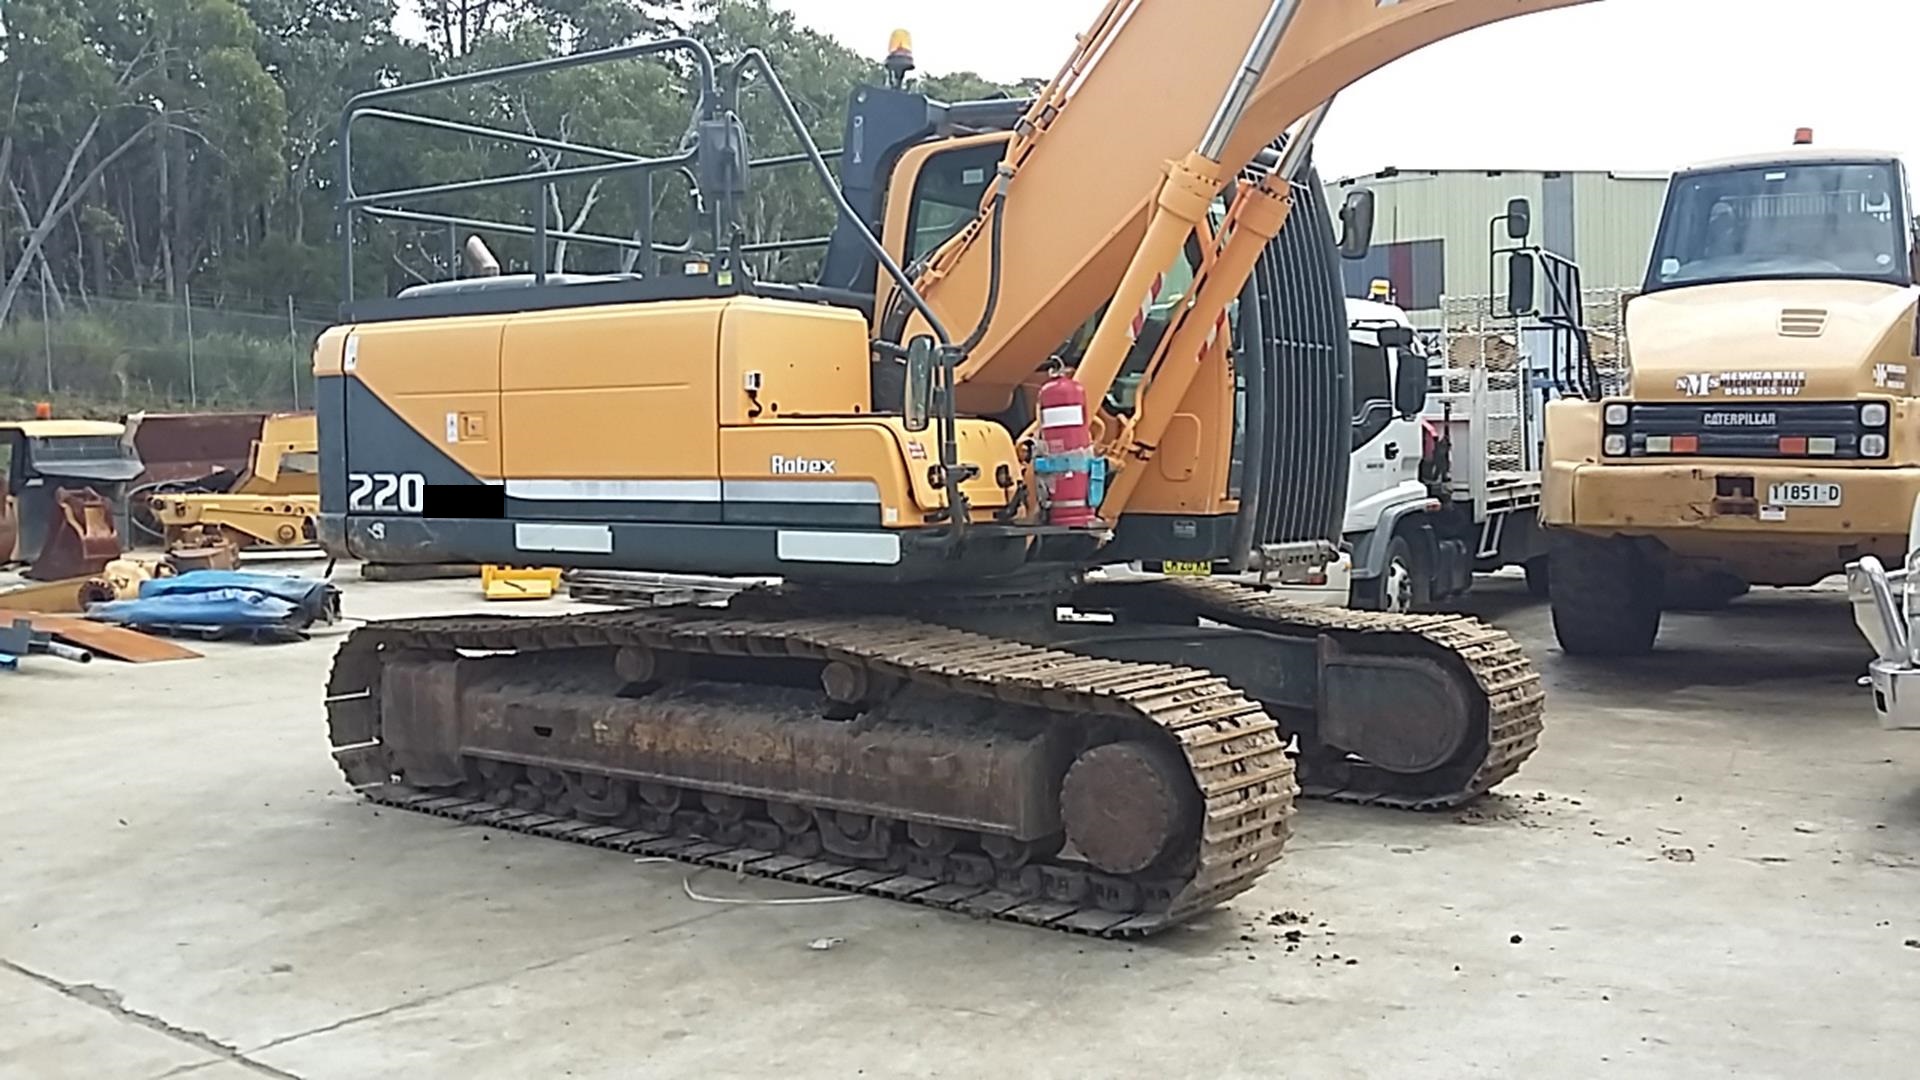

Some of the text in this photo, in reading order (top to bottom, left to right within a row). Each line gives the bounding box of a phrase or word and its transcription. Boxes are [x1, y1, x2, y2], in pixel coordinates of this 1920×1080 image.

[1703, 412, 1777, 426] CATERPILLAR
[771, 454, 836, 475] Robex
[348, 473, 424, 512] 220
